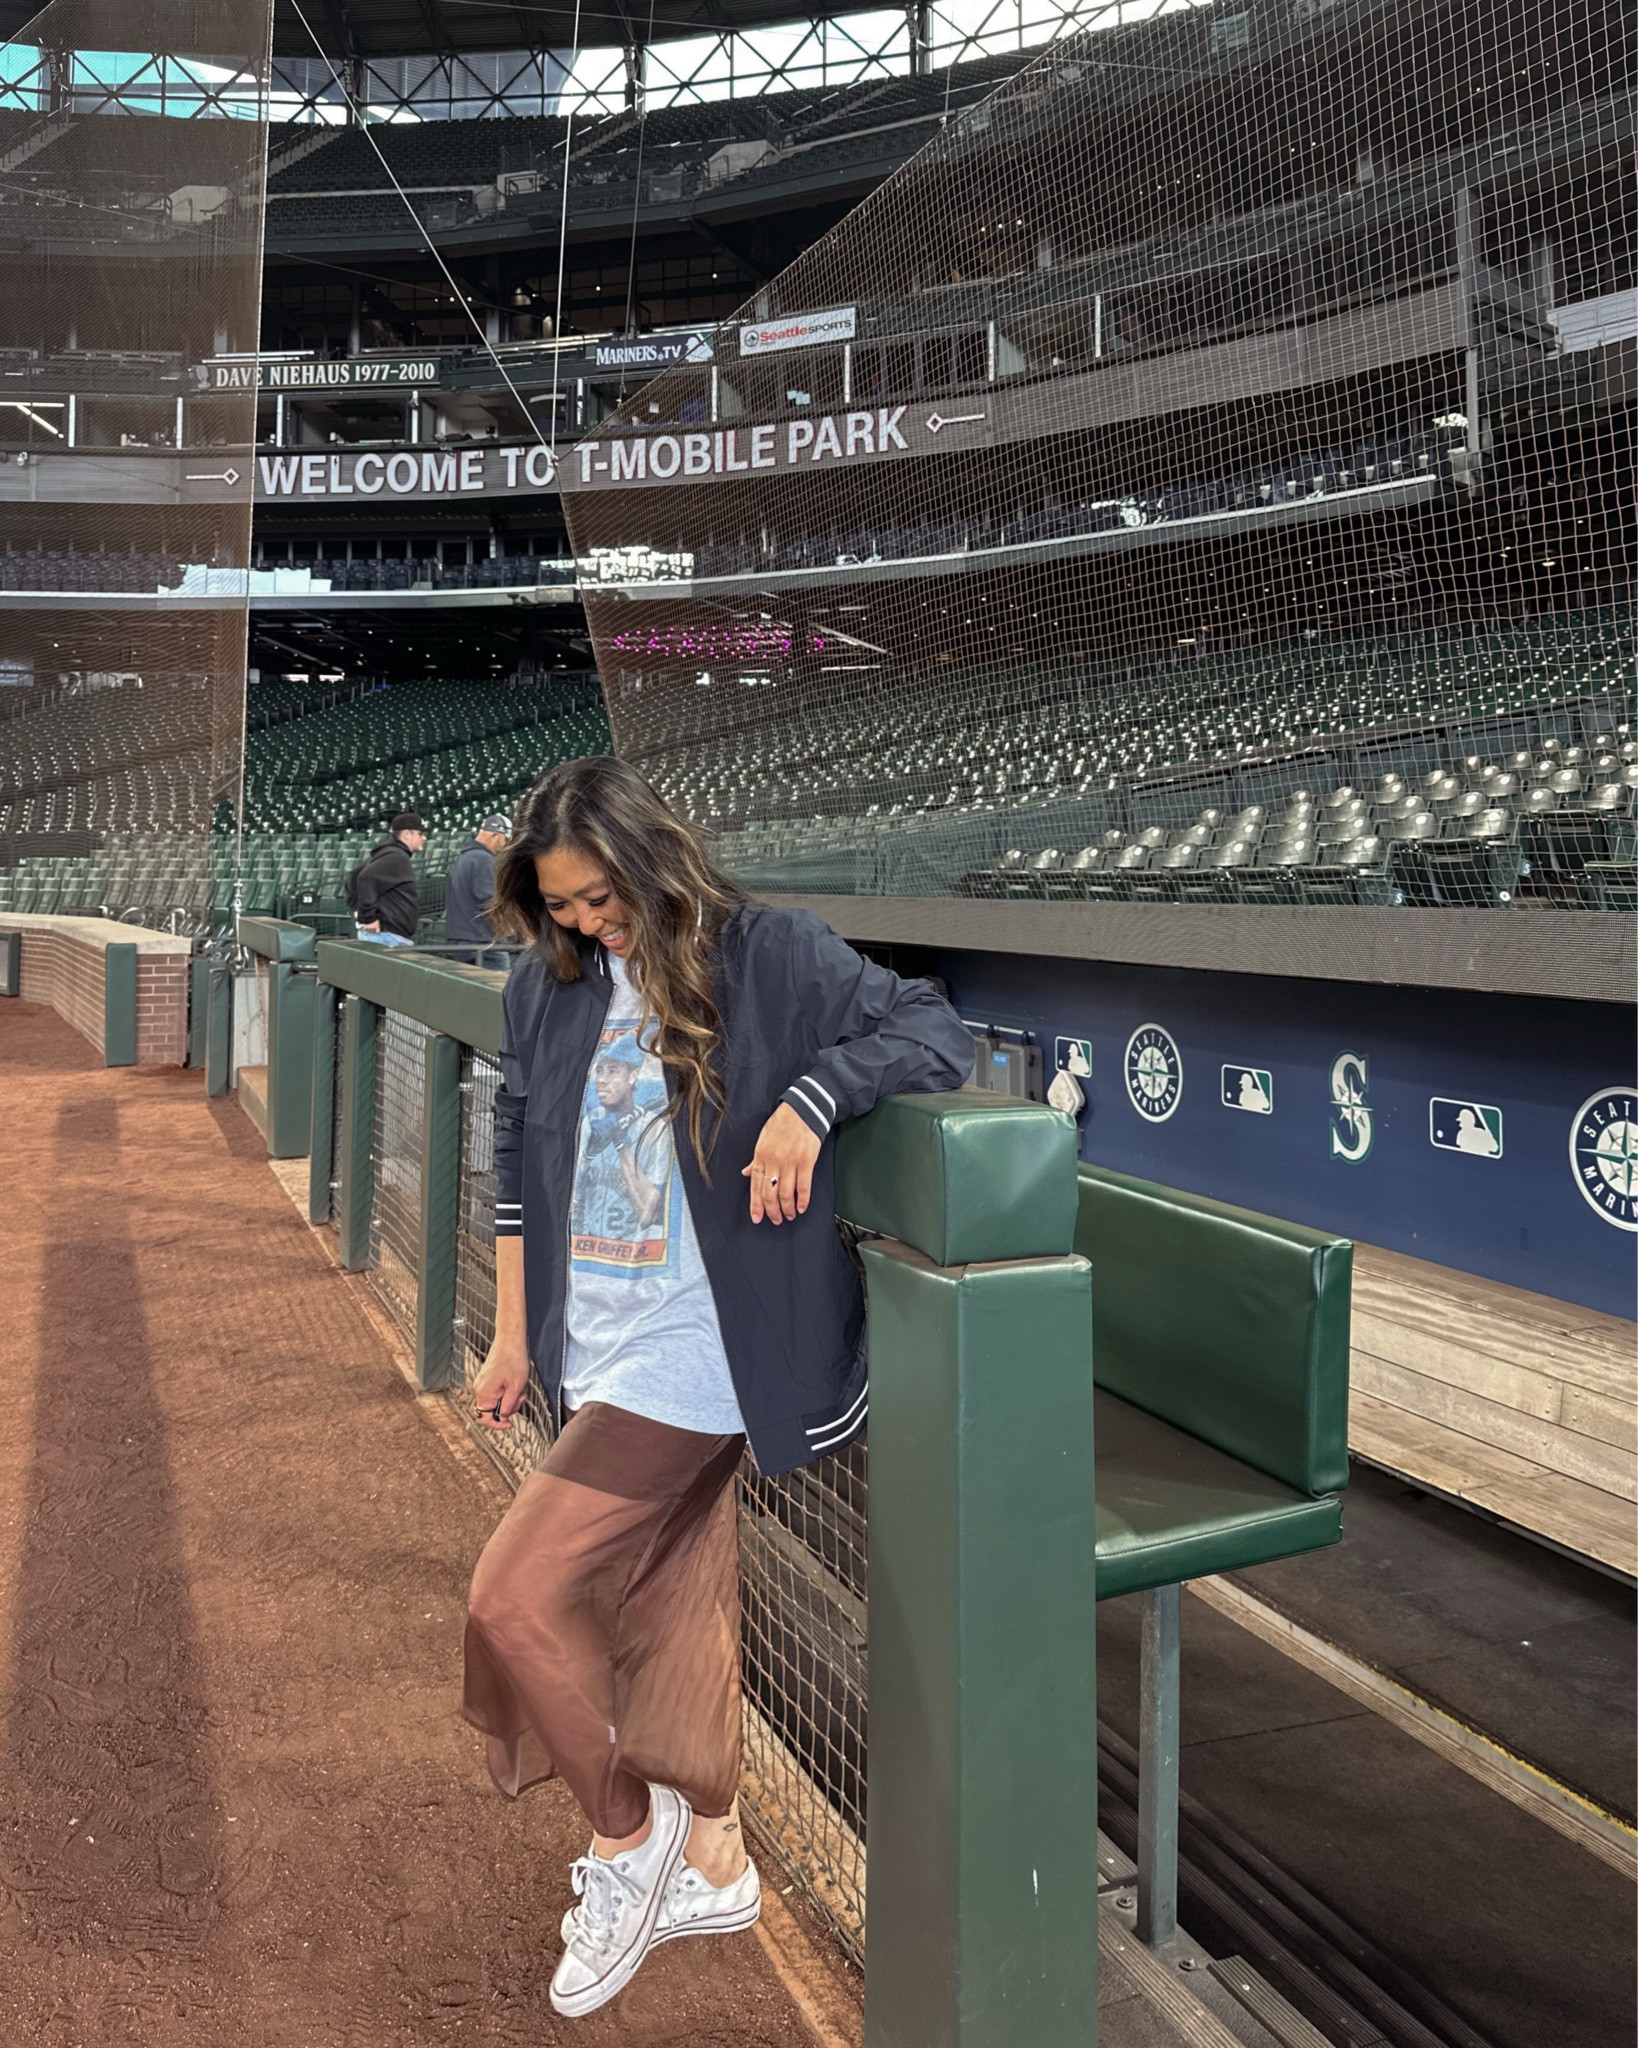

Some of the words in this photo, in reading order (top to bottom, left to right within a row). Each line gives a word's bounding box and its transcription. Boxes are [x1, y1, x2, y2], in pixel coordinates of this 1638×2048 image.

[50, 55, 58, 80] 327
[216, 366, 263, 388] DAVE
[269, 364, 350, 386] NIEHAUS
[354, 362, 435, 382] 1977-2010
[259, 450, 484, 495] WELCOME
[499, 445, 556, 488] TO
[573, 424, 776, 483] T-MOBILE
[787, 405, 910, 464] PARK
[1131, 1032, 1175, 1065] SEATTLE
[1131, 1078, 1177, 1113] MARINERS
[1583, 1100, 1632, 1139] SEAT
[1583, 1165, 1638, 1218] MARIN
[575, 1239, 597, 1253] KEN
